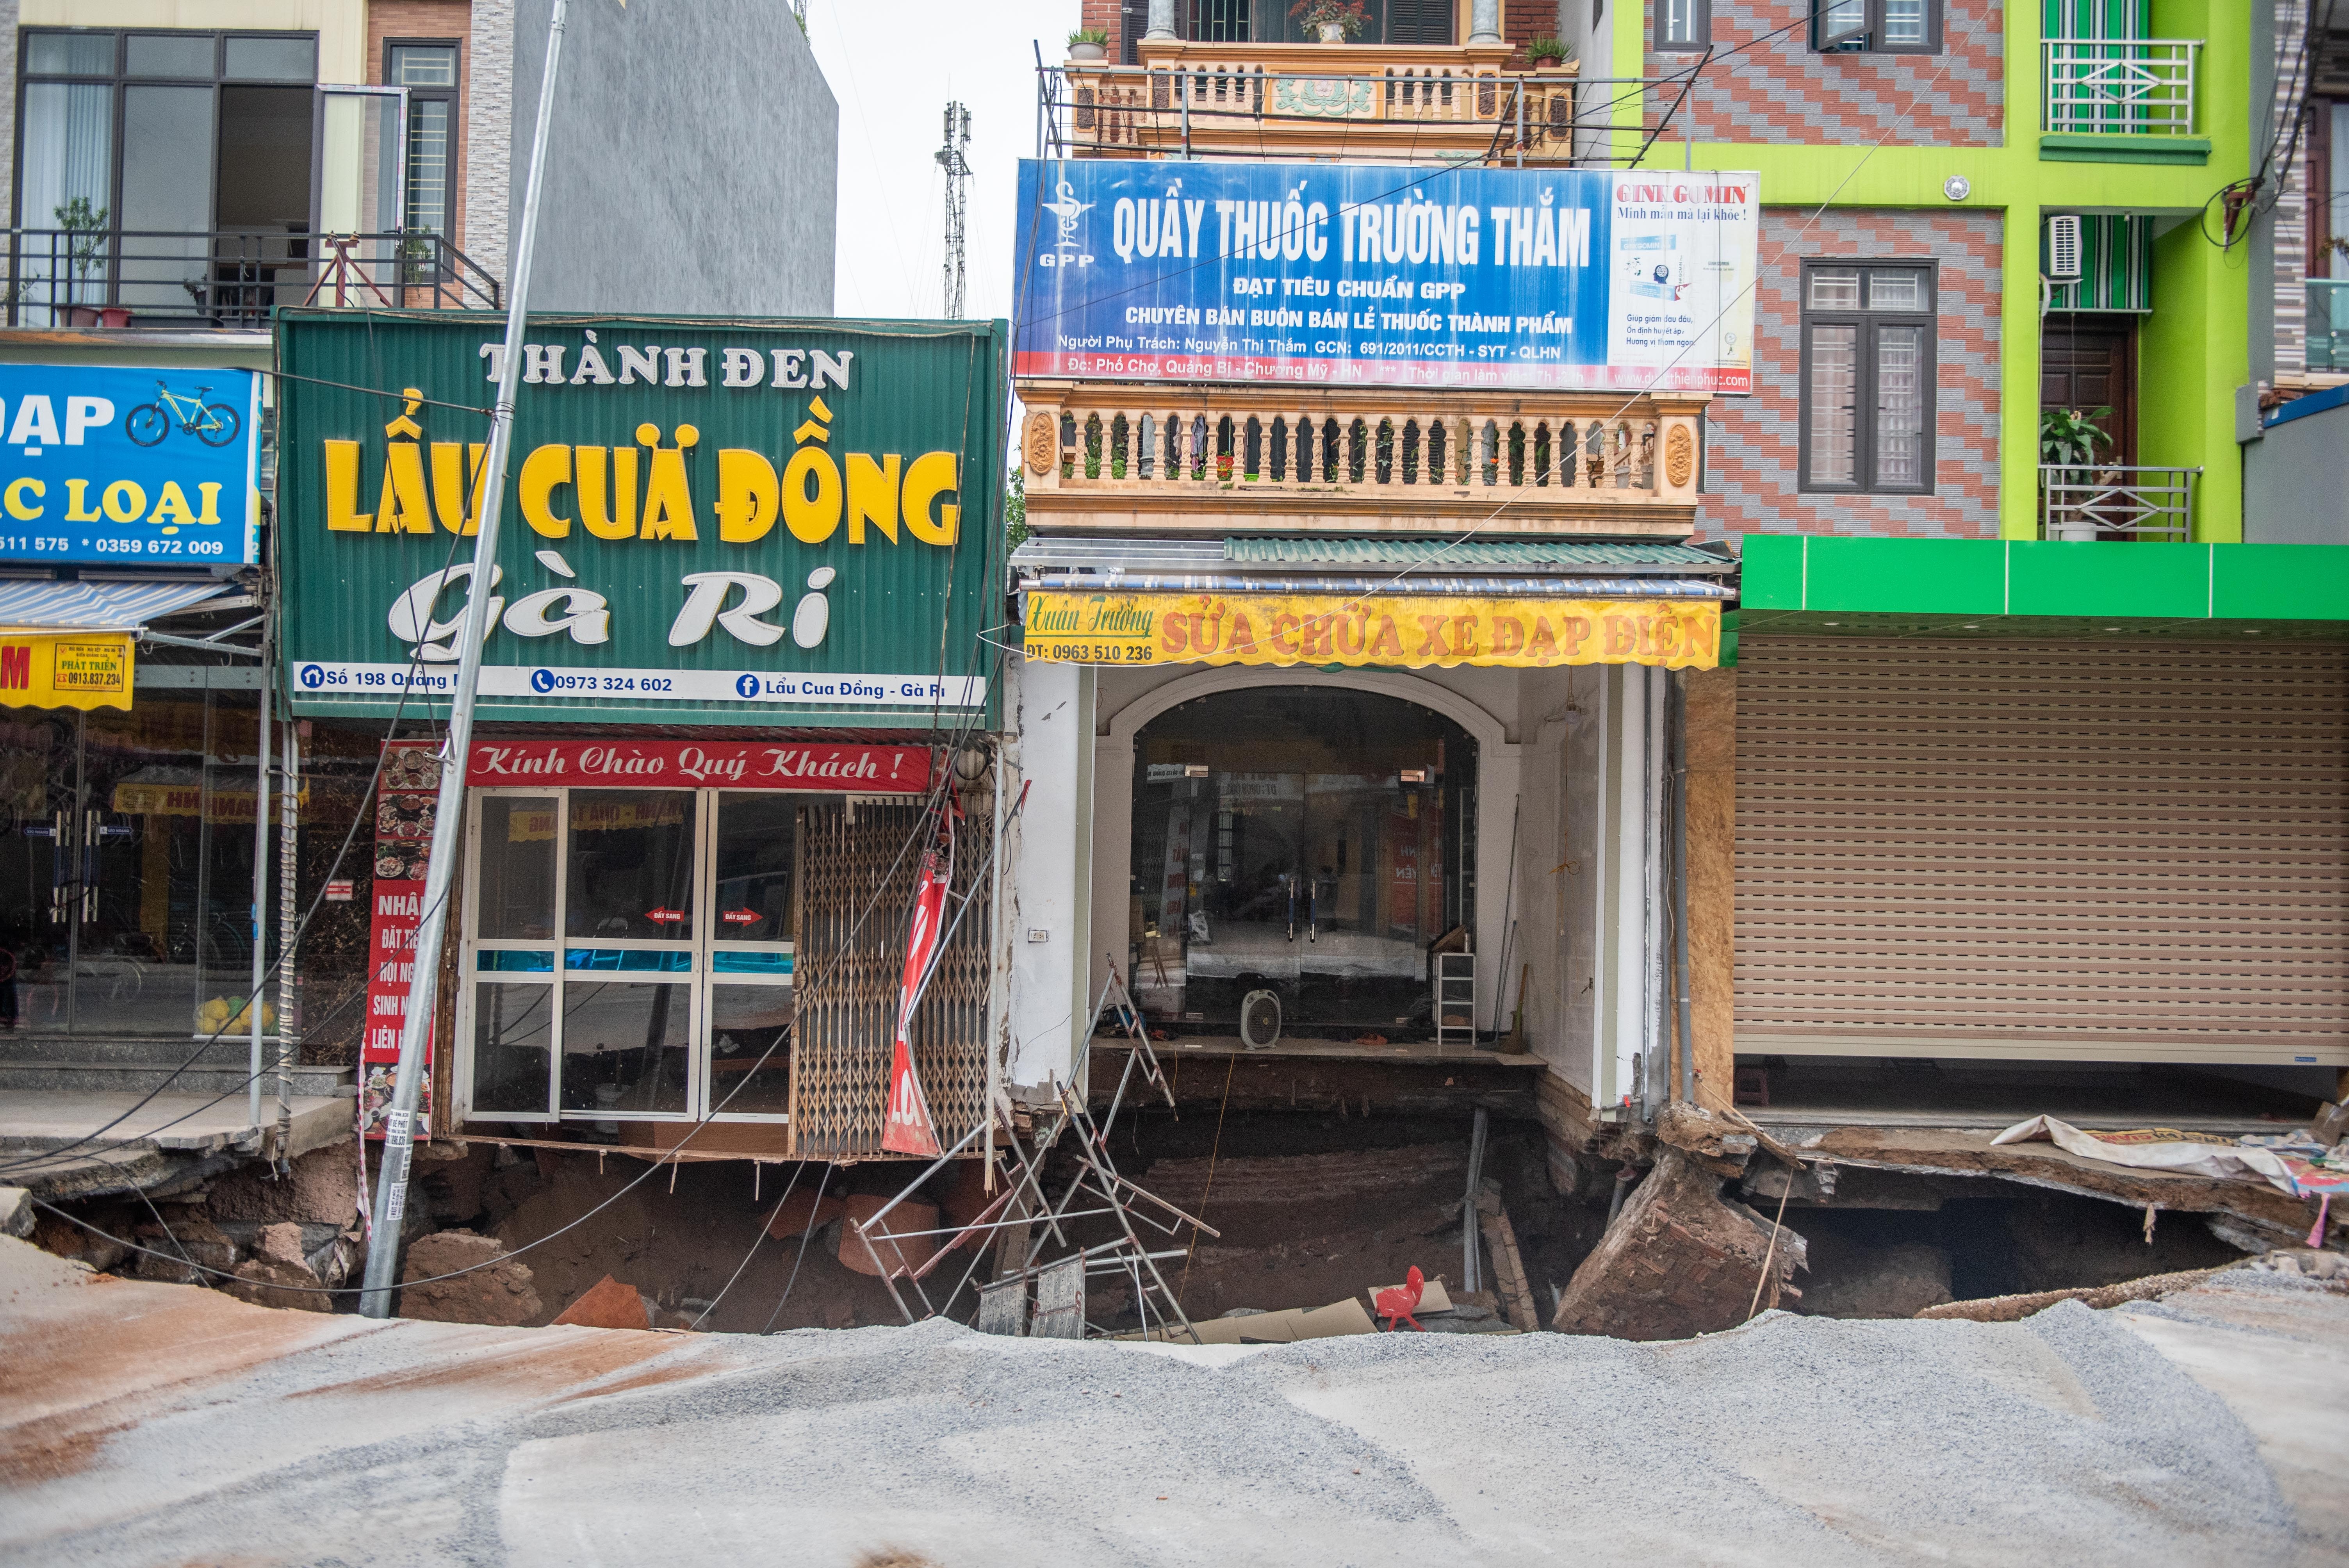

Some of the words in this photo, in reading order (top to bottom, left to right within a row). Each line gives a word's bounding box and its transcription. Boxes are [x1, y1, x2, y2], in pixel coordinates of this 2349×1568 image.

[1114, 178, 1205, 264] QUẦY
[1216, 180, 1328, 262] THUỐC
[1340, 189, 1480, 265] TRƯỜNG
[1491, 187, 1590, 267] THẮM
[1618, 207, 1646, 219] Minh
[1677, 208, 1693, 219] mà
[1697, 208, 1710, 223] lại
[1714, 208, 1739, 220] khỏe
[1039, 254, 1094, 267] GPP
[1233, 278, 1279, 298] ĐẠT
[1283, 276, 1329, 297] TIÊU
[1337, 275, 1413, 298] CHUẨN
[1421, 283, 1466, 299] GPP
[1125, 305, 1199, 325] CHUYÊN
[1206, 306, 1245, 325] BÁN
[1251, 307, 1303, 327] BUÔN
[1309, 308, 1347, 329] BÁN
[1354, 306, 1375, 330] LẺ
[1381, 308, 1442, 331] THUỐC
[1447, 312, 1510, 332] THÀNH
[1516, 311, 1572, 333] PHẨM
[1058, 335, 1101, 351] Người
[1106, 336, 1132, 349] Phụ
[1137, 335, 1180, 349] Trách:
[1185, 336, 1237, 352] Nguyễn
[1242, 338, 1264, 353] Thị
[1268, 336, 1306, 352] Thắm
[1315, 341, 1351, 354] GCN:
[1360, 342, 1465, 358] 691/2011/CCTH
[1478, 346, 1506, 358] SYT
[1519, 346, 1560, 360] QLHN
[479, 330, 708, 387] THÀNH
[722, 348, 854, 390] ĐEN
[1068, 358, 1091, 371] Đc:
[1096, 357, 1124, 372] Phố
[1166, 359, 1211, 377] Quảng
[1217, 361, 1231, 374] Bị
[1246, 361, 1302, 378] Chương
[1308, 364, 1328, 377] Mỹ
[1342, 365, 1362, 378] HN
[1615, 372, 1748, 387] www.ducthienphuc.com
[0, 394, 115, 456] ẠP
[324, 388, 491, 536] LẨU
[714, 395, 961, 546] ĐỒNG
[0, 478, 46, 520] C
[64, 479, 223, 535] LOẠI
[35, 538, 69, 551] 575
[96, 539, 142, 553] 0359
[148, 540, 182, 554] 672
[188, 541, 223, 555] 009
[1028, 595, 1080, 631] Xuân
[1088, 596, 1153, 638] Trường
[1162, 595, 1258, 655] SỬA
[1271, 601, 1404, 656] CHỮA
[1416, 615, 1478, 657] XE
[1491, 616, 1591, 666] ĐẠP
[1604, 603, 1716, 667] ĐIỆN
[62, 659, 86, 670] PHÁT
[89, 657, 116, 671] TRIỂN
[1026, 645, 1048, 659] ĐT:
[1053, 645, 1089, 659] 0963
[1094, 645, 1121, 659] 510
[1126, 646, 1152, 660] 236
[69, 672, 120, 685] 0913.837.234
[327, 668, 348, 684] Số
[355, 672, 385, 686] 198
[391, 671, 446, 689] Quảng
[555, 676, 597, 689] 0973
[603, 677, 634, 690] 324
[641, 678, 672, 691] 602
[766, 677, 795, 694] Lẩu
[802, 681, 834, 695] Cua
[839, 680, 883, 698] Đồng
[901, 682, 923, 697] Gà
[472, 747, 567, 775] Kính
[579, 747, 668, 775] Chào
[678, 747, 749, 781] Quý
[757, 748, 880, 779] Khách
[891, 754, 904, 780] !
[382, 925, 402, 953] ĐẶT
[405, 925, 419, 953] TIỆ
[380, 960, 397, 986] HỘI
[373, 995, 398, 1015] SINH
[372, 1025, 395, 1049] LIÊN
